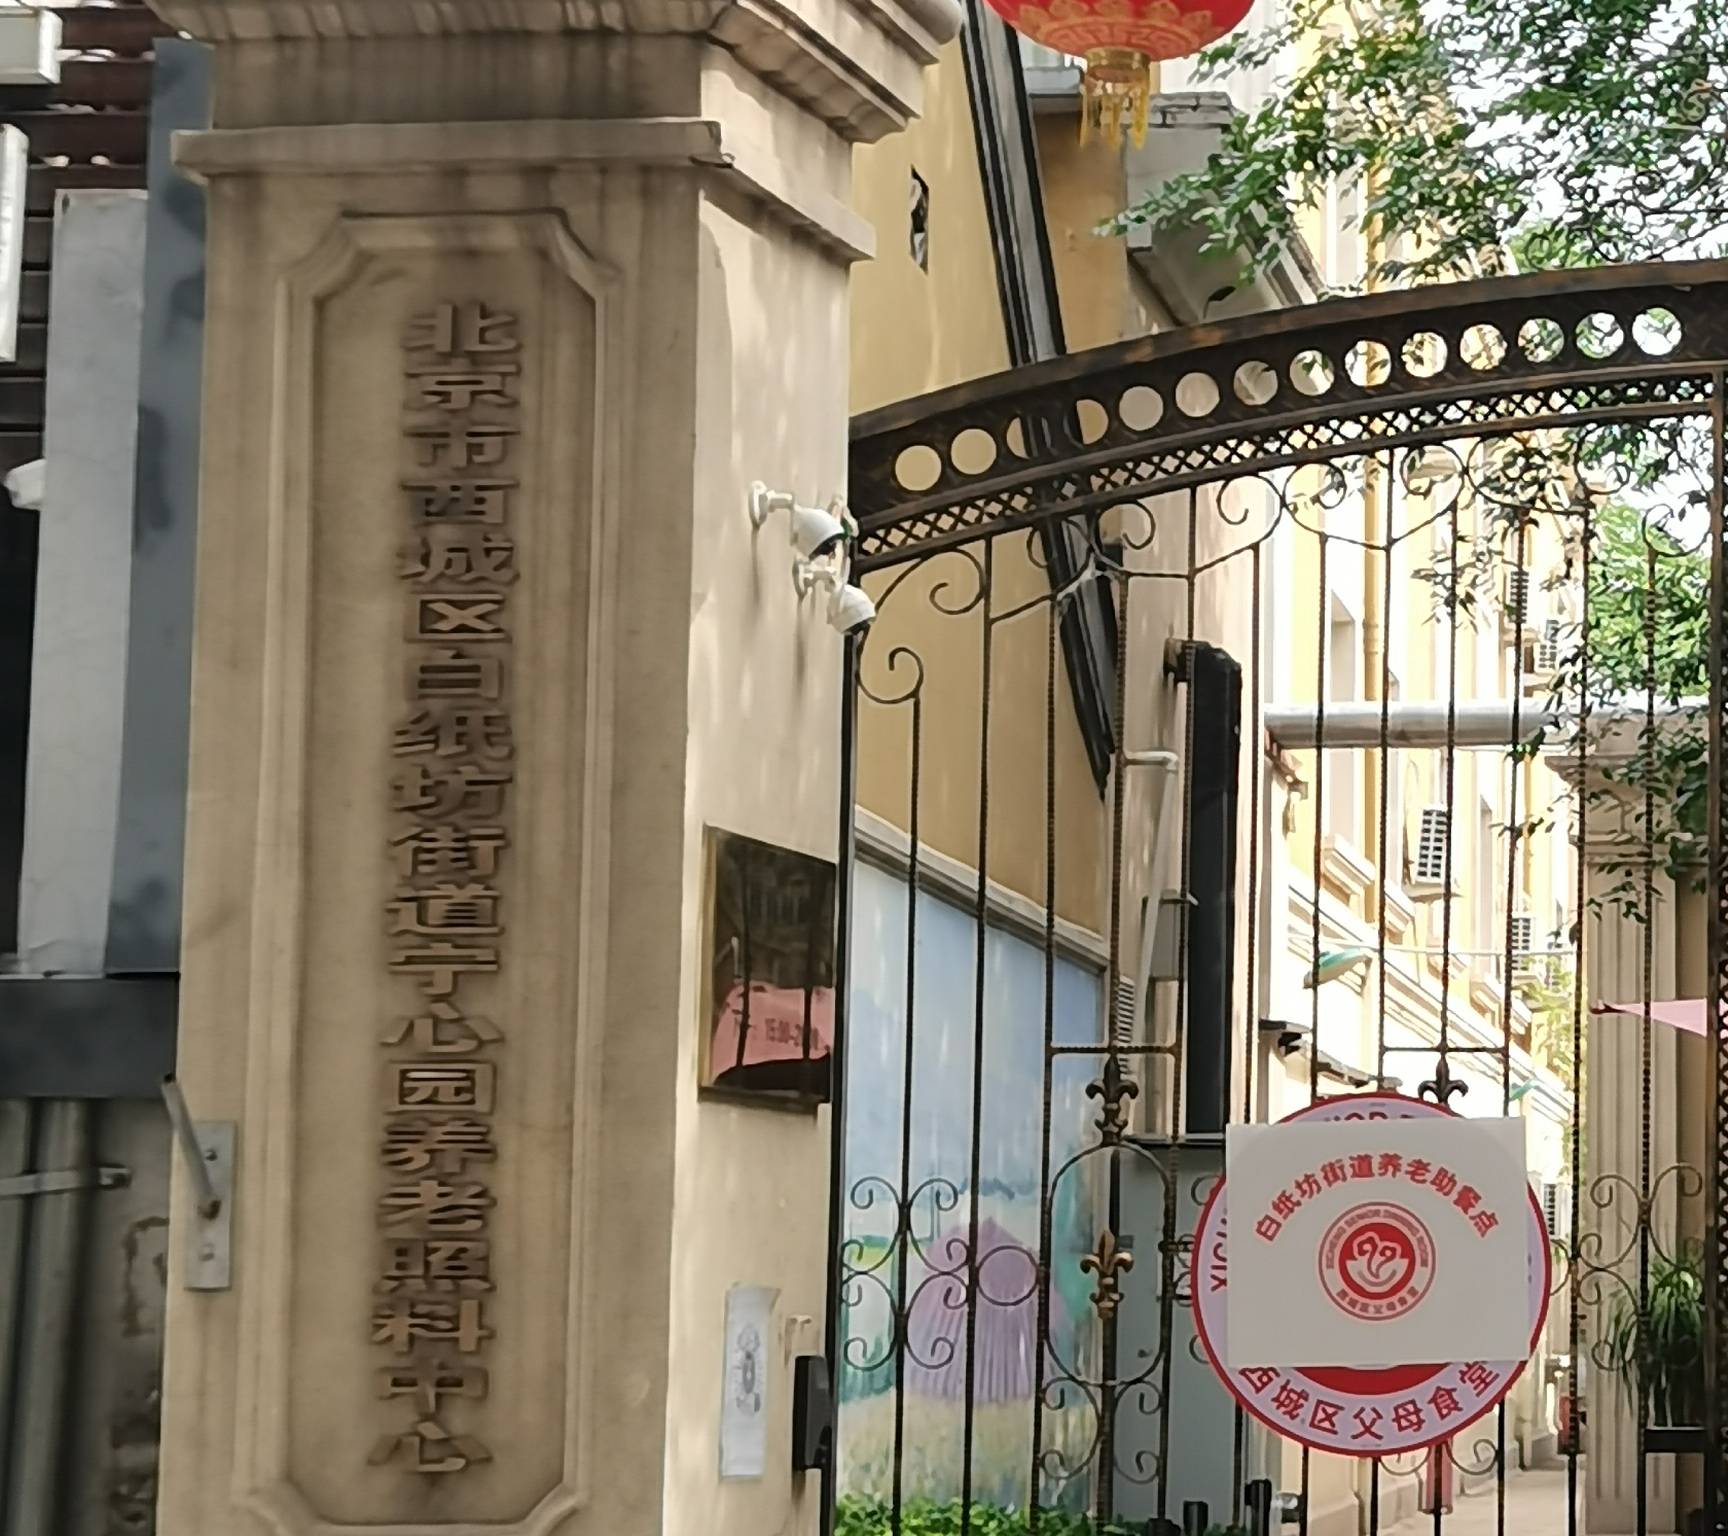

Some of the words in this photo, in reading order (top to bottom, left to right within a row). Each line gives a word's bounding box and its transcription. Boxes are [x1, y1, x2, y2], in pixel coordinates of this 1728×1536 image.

[367, 301, 522, 1474] 北京市西城区白纸坊街道宁心园养老照料中心
[1254, 1152, 1500, 1242] 白纸坊街道养老助餐点
[1238, 1360, 1500, 1441] 西城区父母食堂
